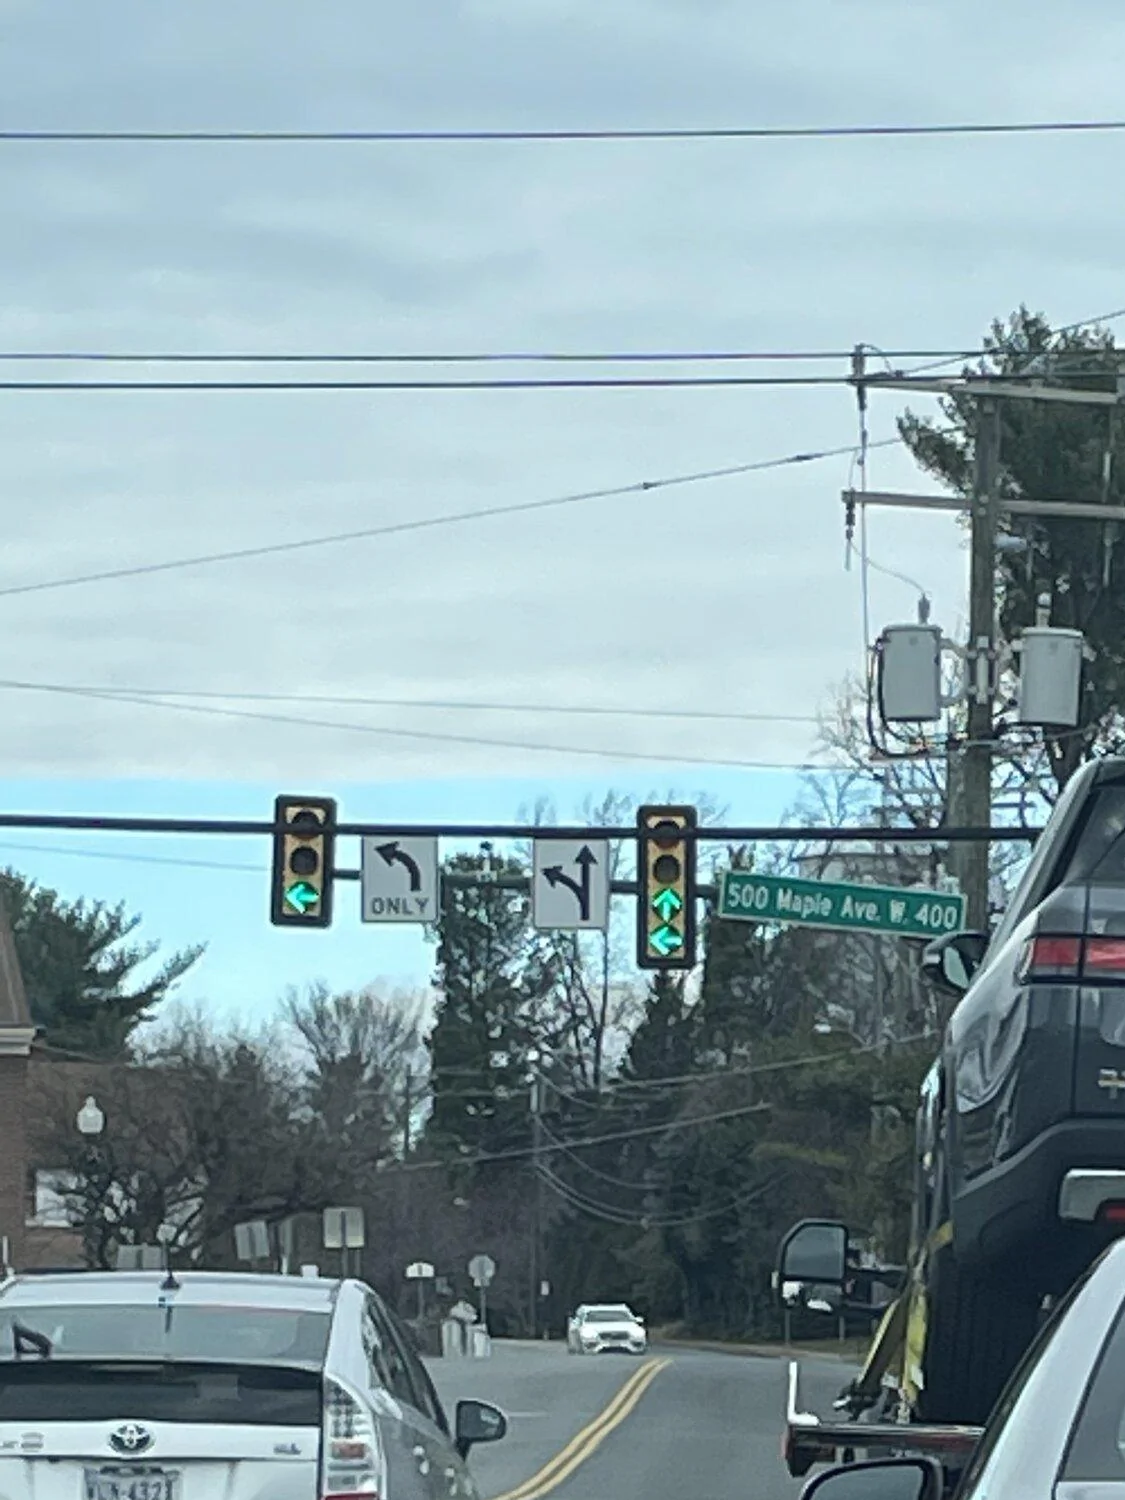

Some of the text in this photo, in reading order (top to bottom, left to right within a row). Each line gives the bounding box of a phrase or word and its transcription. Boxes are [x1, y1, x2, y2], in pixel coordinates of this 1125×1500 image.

[371, 897, 430, 915] ONLY
[727, 882, 769, 911] 500
[776, 888, 833, 918] Maple
[839, 895, 881, 922] Ave.
[914, 905, 958, 930] 400
